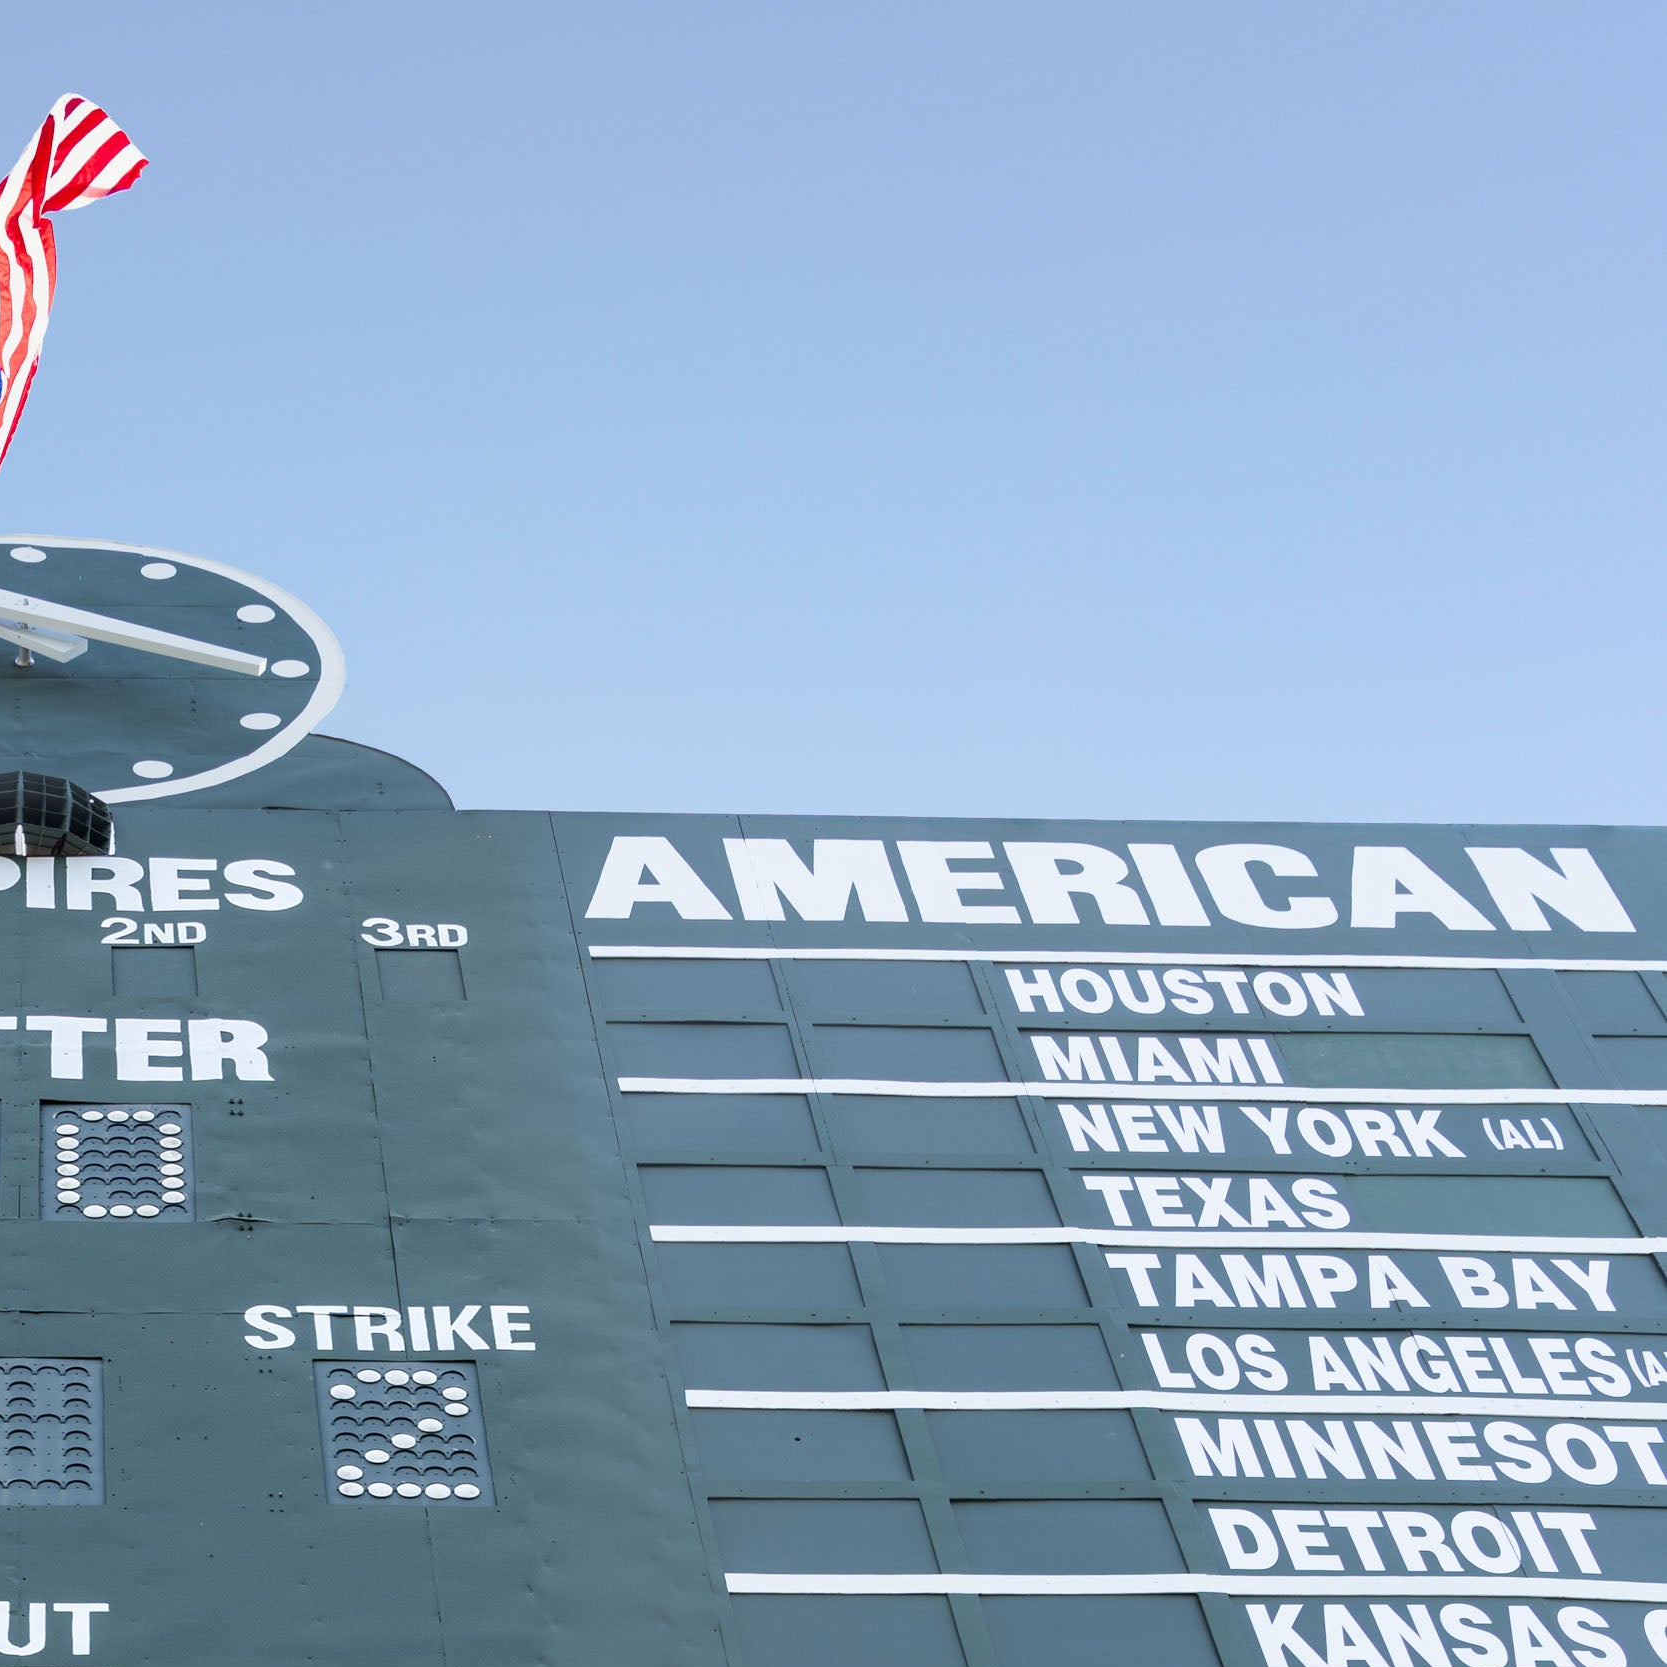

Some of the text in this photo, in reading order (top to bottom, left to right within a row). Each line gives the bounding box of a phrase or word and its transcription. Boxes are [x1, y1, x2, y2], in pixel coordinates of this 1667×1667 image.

[585, 836, 1636, 932] AMERICAN
[101, 917, 207, 945] 2ND
[361, 918, 467, 946] 3RD
[1004, 968, 1365, 1018] HOUSTON
[1029, 1036, 1285, 1085] MIAMI
[1056, 1103, 1563, 1158] NEW YORK (AL)
[1082, 1175, 1351, 1230] TEXAS
[1104, 1252, 1617, 1312] TAMPA BAY
[244, 1305, 535, 1351] STRIKE
[1140, 1333, 1667, 1398] LOS ANGELES (A
[1174, 1417, 1667, 1486] MINNESOT
[1206, 1507, 1603, 1575] DETROIT
